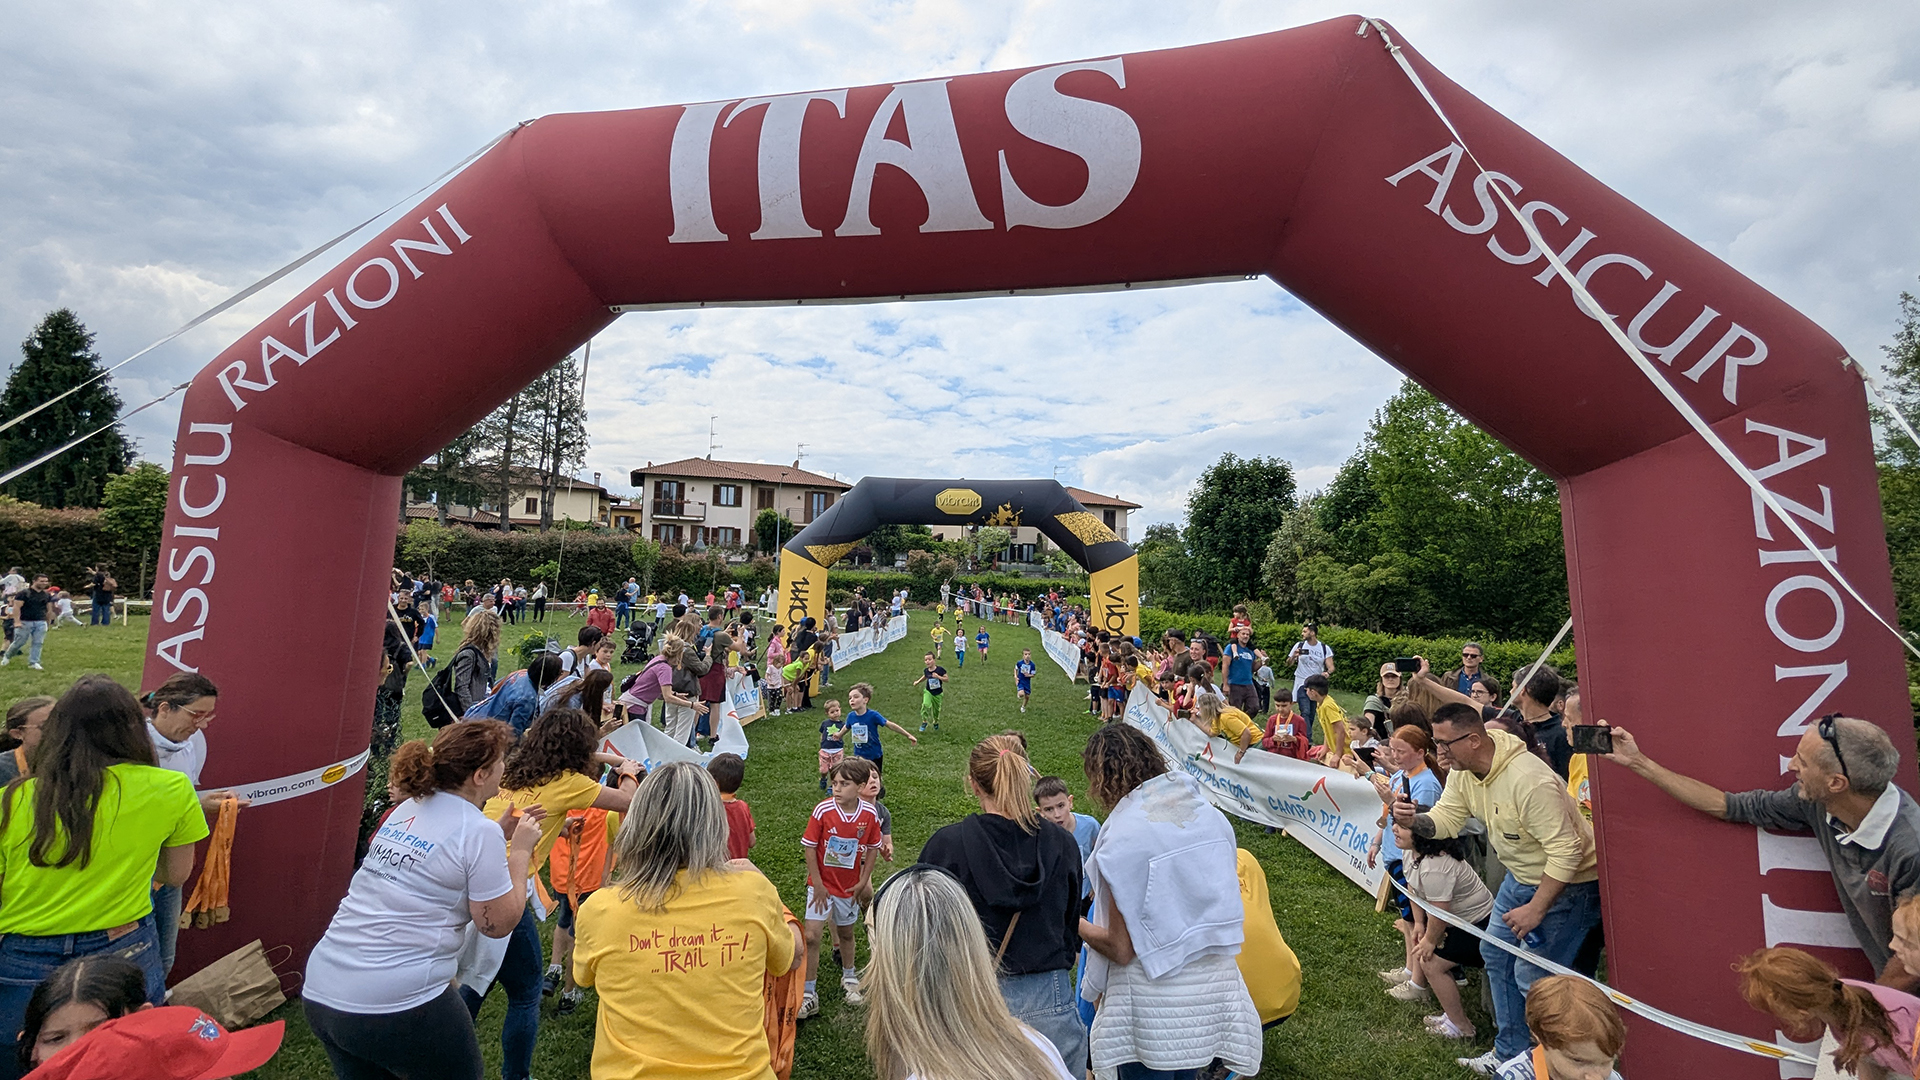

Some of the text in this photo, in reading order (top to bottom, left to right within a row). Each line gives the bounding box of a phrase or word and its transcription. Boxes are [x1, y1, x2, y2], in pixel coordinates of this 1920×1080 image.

[668, 57, 1141, 243] ITAS
[1384, 141, 1768, 405] ASSICUR
[1745, 418, 1848, 774] AZION
[938, 494, 981, 507] vibram
[247, 777, 315, 800] vibram.com
[1268, 795, 1371, 854] CAMPO DEI FIOR
[389, 829, 405, 842] DEI
[403, 834, 435, 853] FIORI
[410, 848, 427, 860] TRAIL
[1349, 855, 1368, 875] TRAIL
[629, 928, 665, 953] Don't
[669, 926, 705, 947] dream
